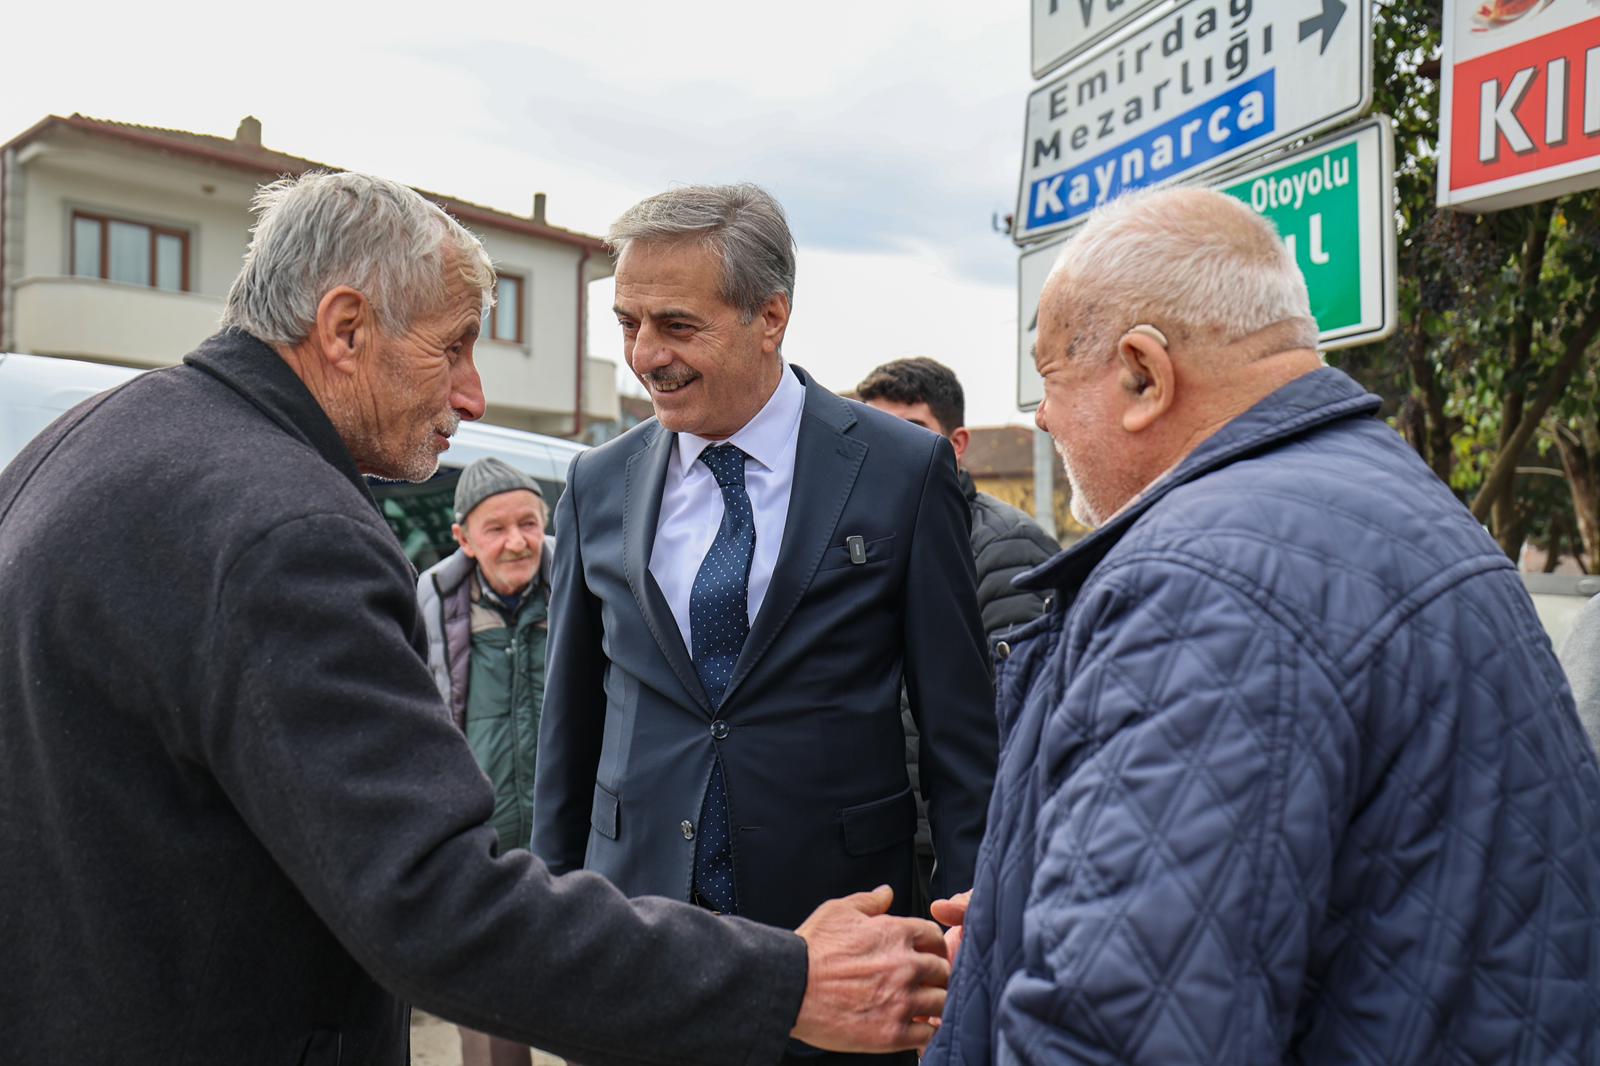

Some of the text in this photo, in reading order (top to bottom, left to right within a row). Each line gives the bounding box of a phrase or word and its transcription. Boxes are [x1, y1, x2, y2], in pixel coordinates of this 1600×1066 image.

[1032, 24, 1272, 168] Mezarlığı
[1034, 90, 1264, 219] Kaynarca
[1251, 154, 1349, 213] Otoyolu
